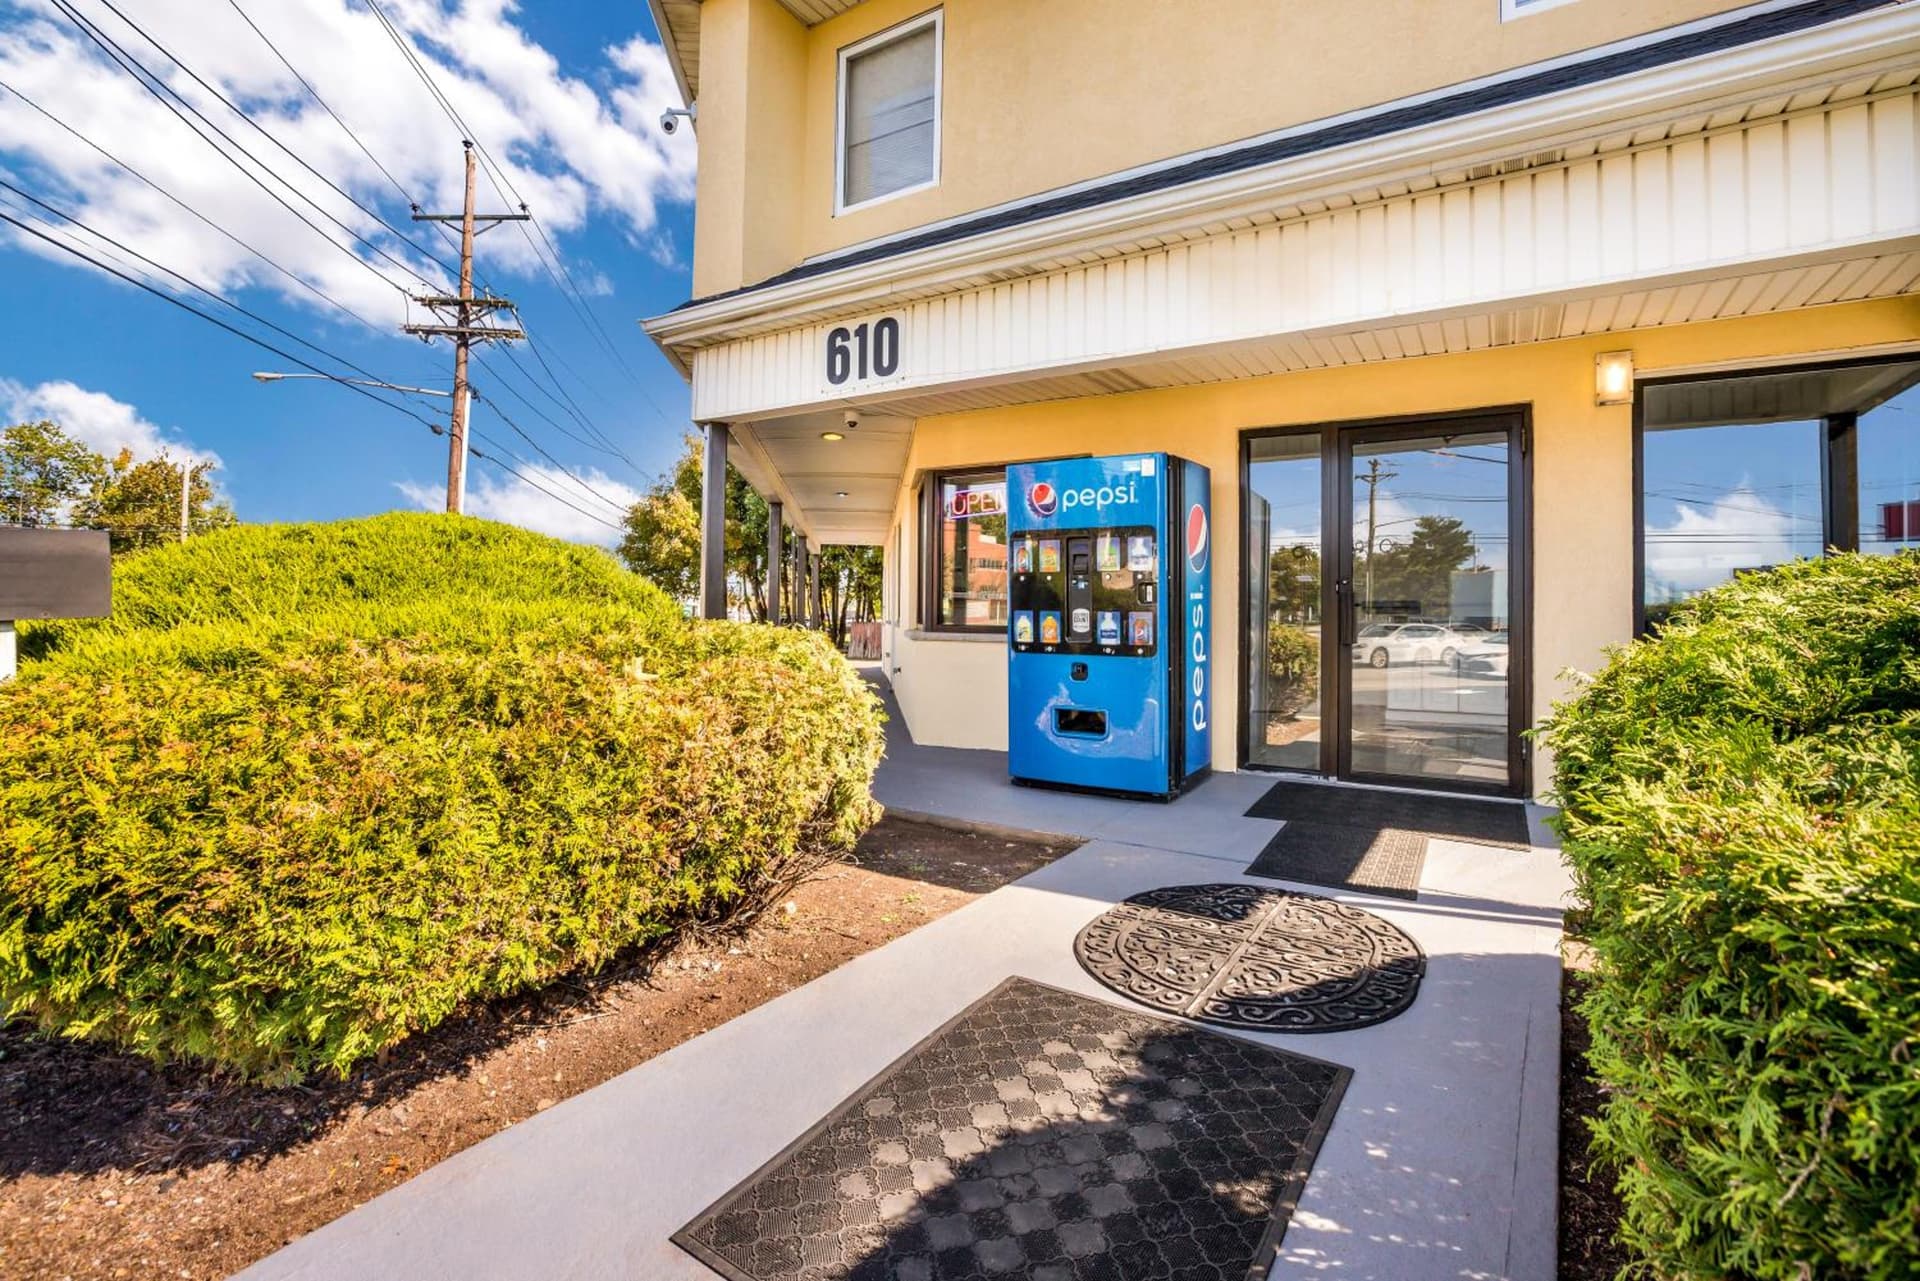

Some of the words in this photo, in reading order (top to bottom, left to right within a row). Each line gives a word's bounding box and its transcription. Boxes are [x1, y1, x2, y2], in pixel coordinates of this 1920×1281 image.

[827, 317, 899, 385] 610
[1062, 481, 1136, 512] pepsi
[1190, 591, 1206, 732] pepsi
